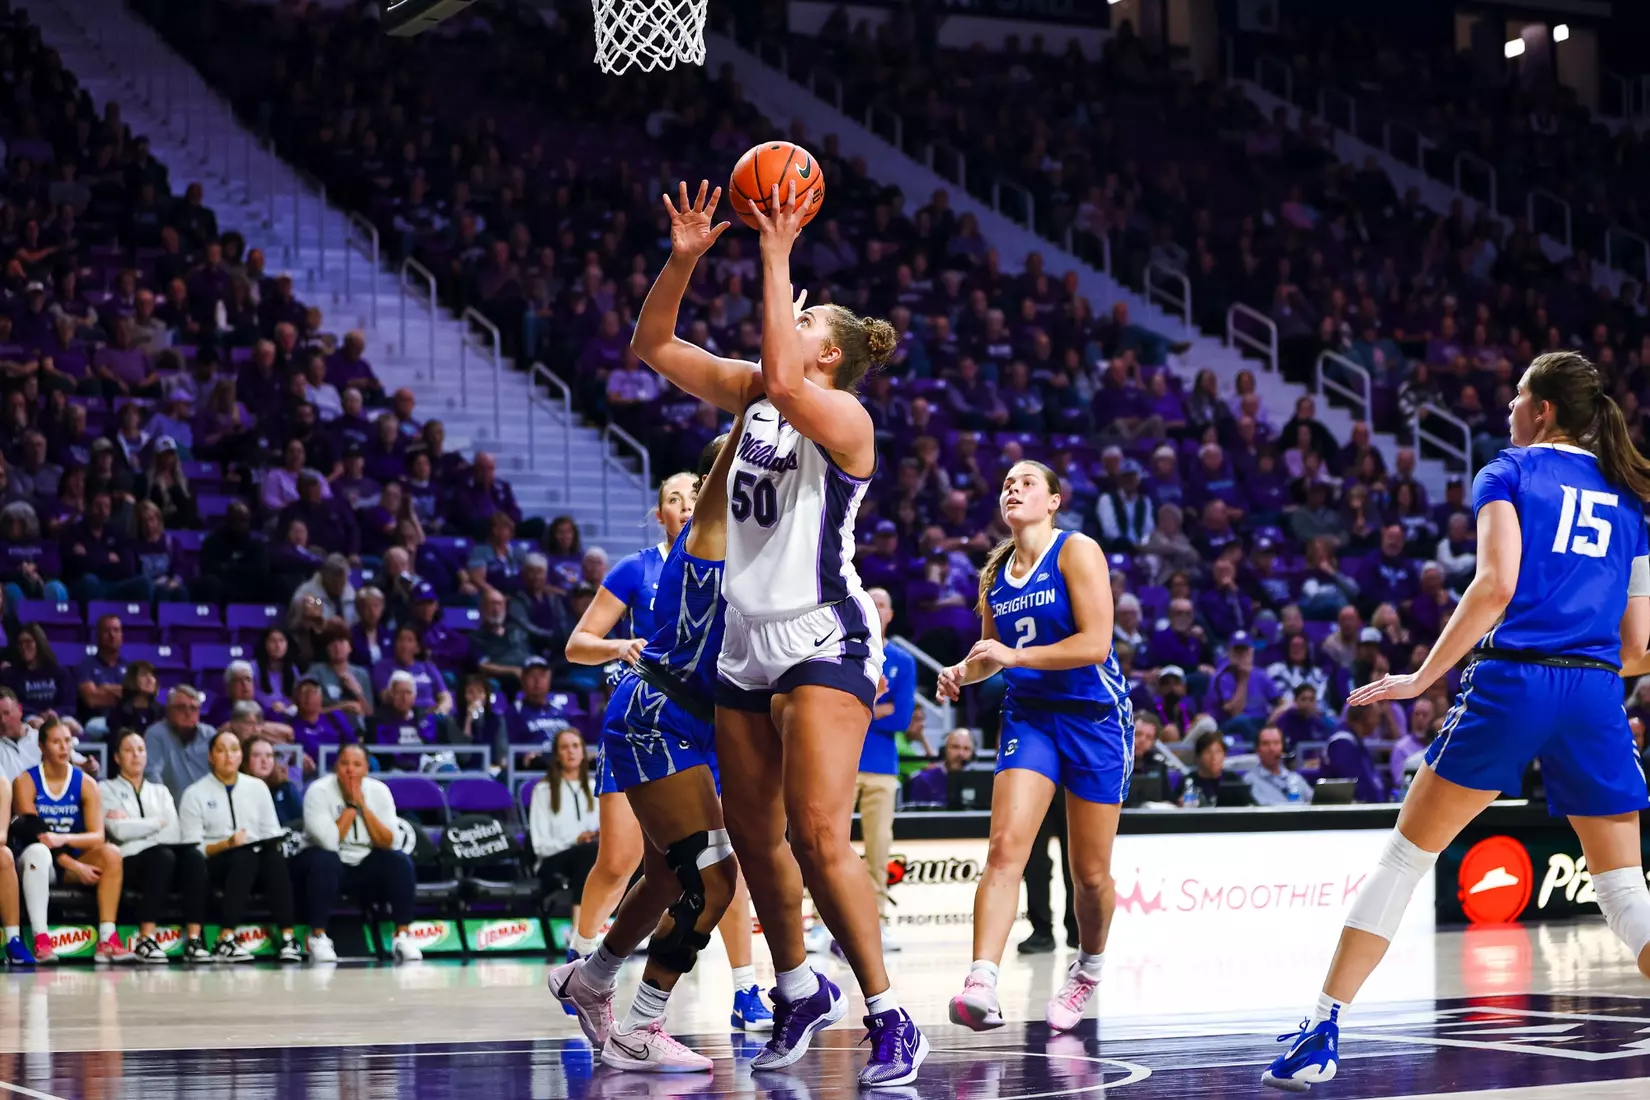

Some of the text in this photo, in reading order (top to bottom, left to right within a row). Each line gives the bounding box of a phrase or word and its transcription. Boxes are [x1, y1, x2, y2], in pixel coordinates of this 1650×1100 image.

[731, 469, 777, 528] 50
[1551, 484, 1619, 557] 15
[1014, 616, 1037, 649] 2
[447, 819, 502, 843] Capitol
[453, 834, 509, 859] Federal
[1176, 878, 1335, 912] SMOOTHIE
